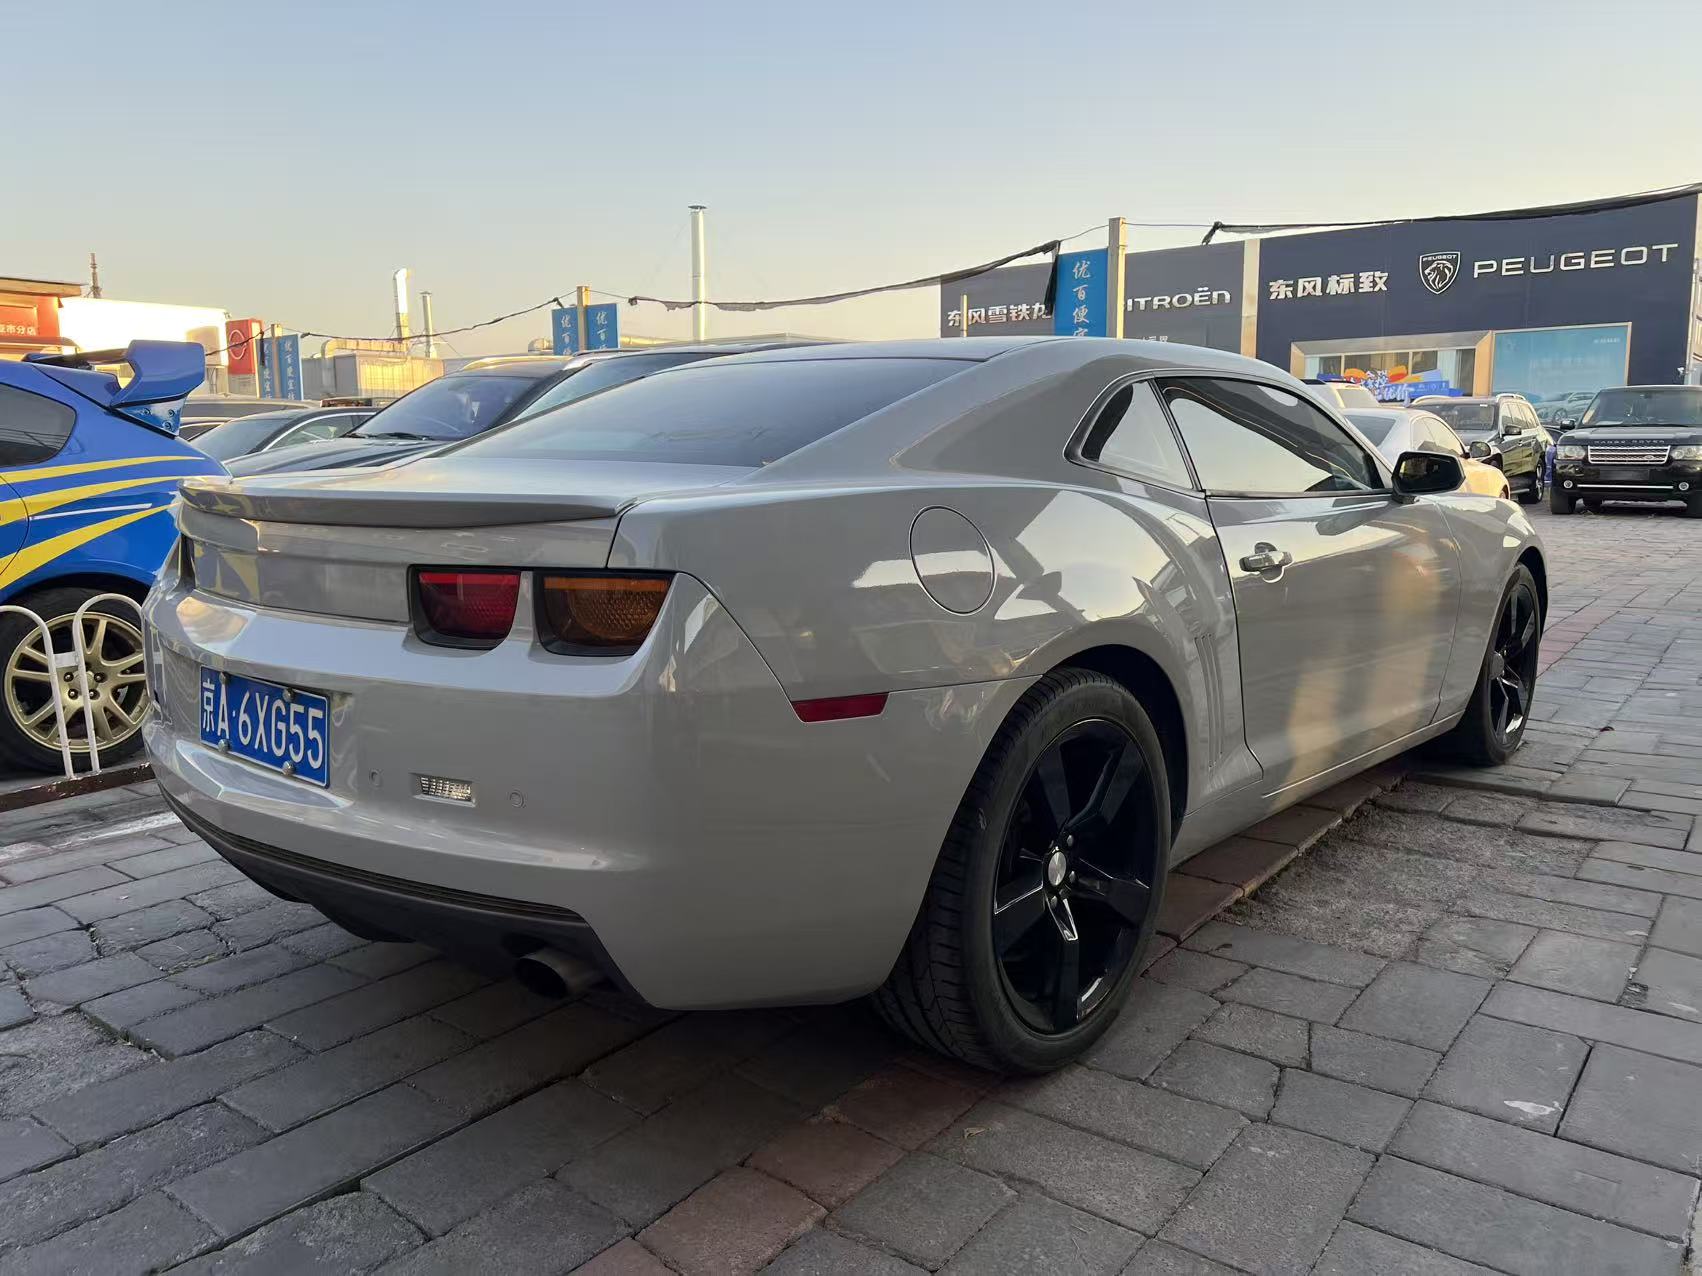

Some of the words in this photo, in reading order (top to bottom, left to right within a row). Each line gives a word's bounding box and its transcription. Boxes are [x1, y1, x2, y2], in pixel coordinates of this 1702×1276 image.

[1473, 243, 1679, 279] PEUGEOT
[1269, 270, 1389, 300] 东风标致
